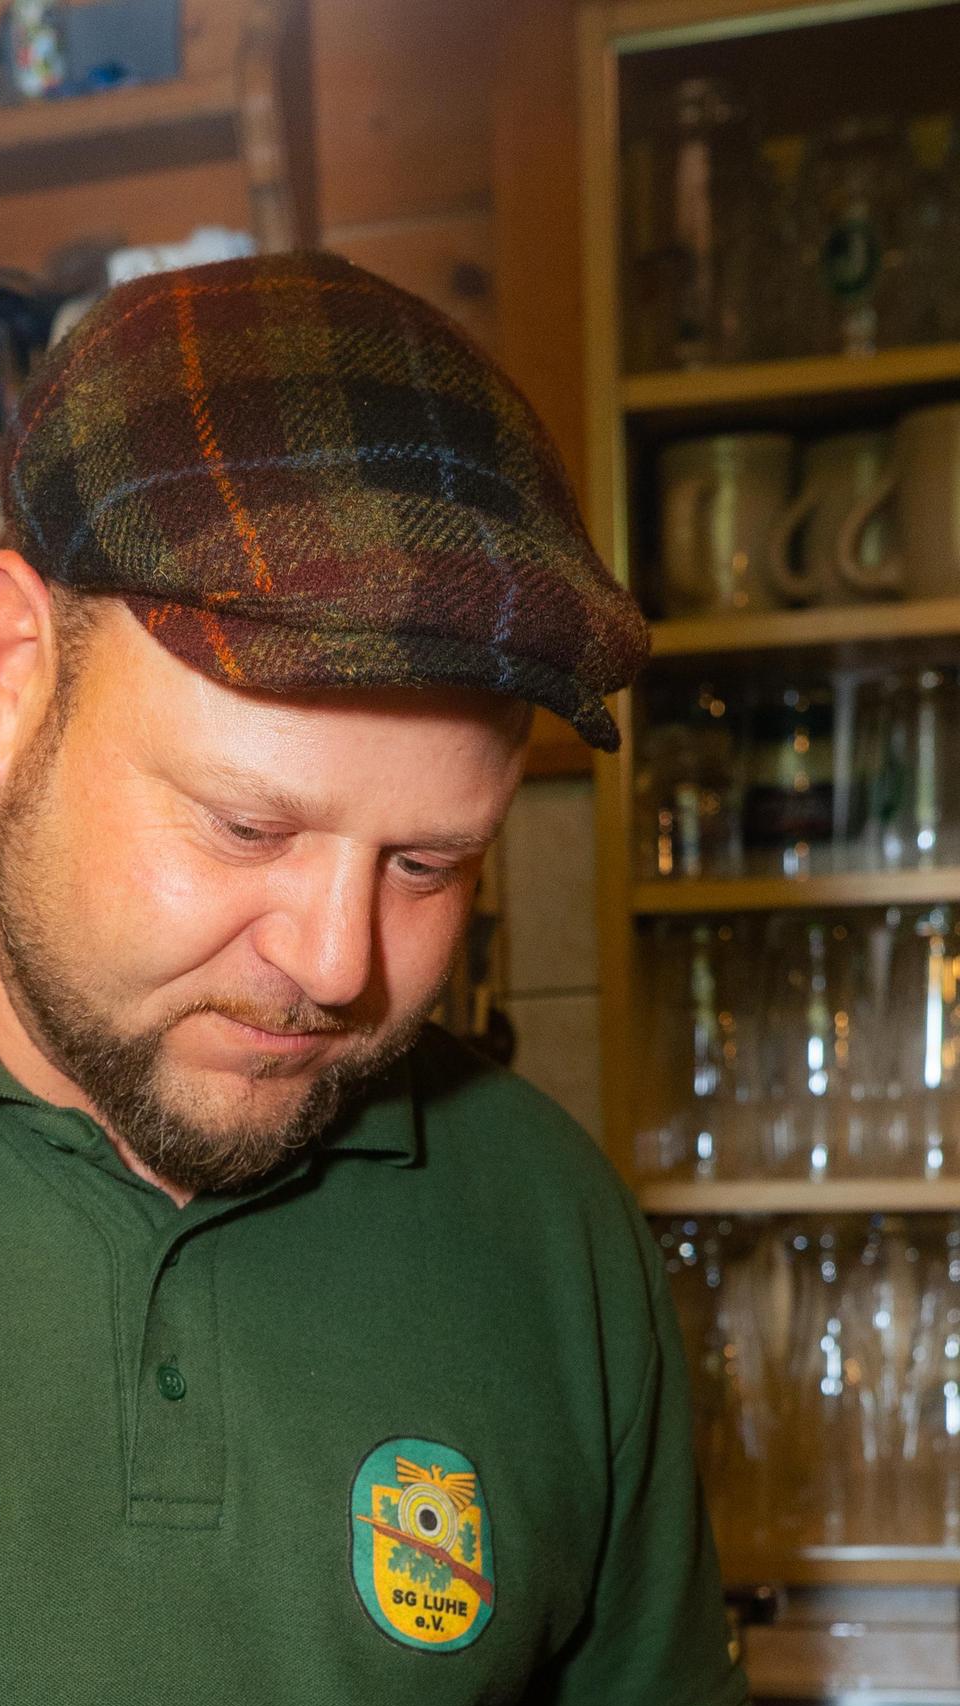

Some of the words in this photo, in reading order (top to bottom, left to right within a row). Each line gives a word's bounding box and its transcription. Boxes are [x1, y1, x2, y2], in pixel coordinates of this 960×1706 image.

[392, 1588, 417, 1606] SG
[423, 1594, 468, 1617] LUHE
[415, 1615, 445, 1632] e.V.
